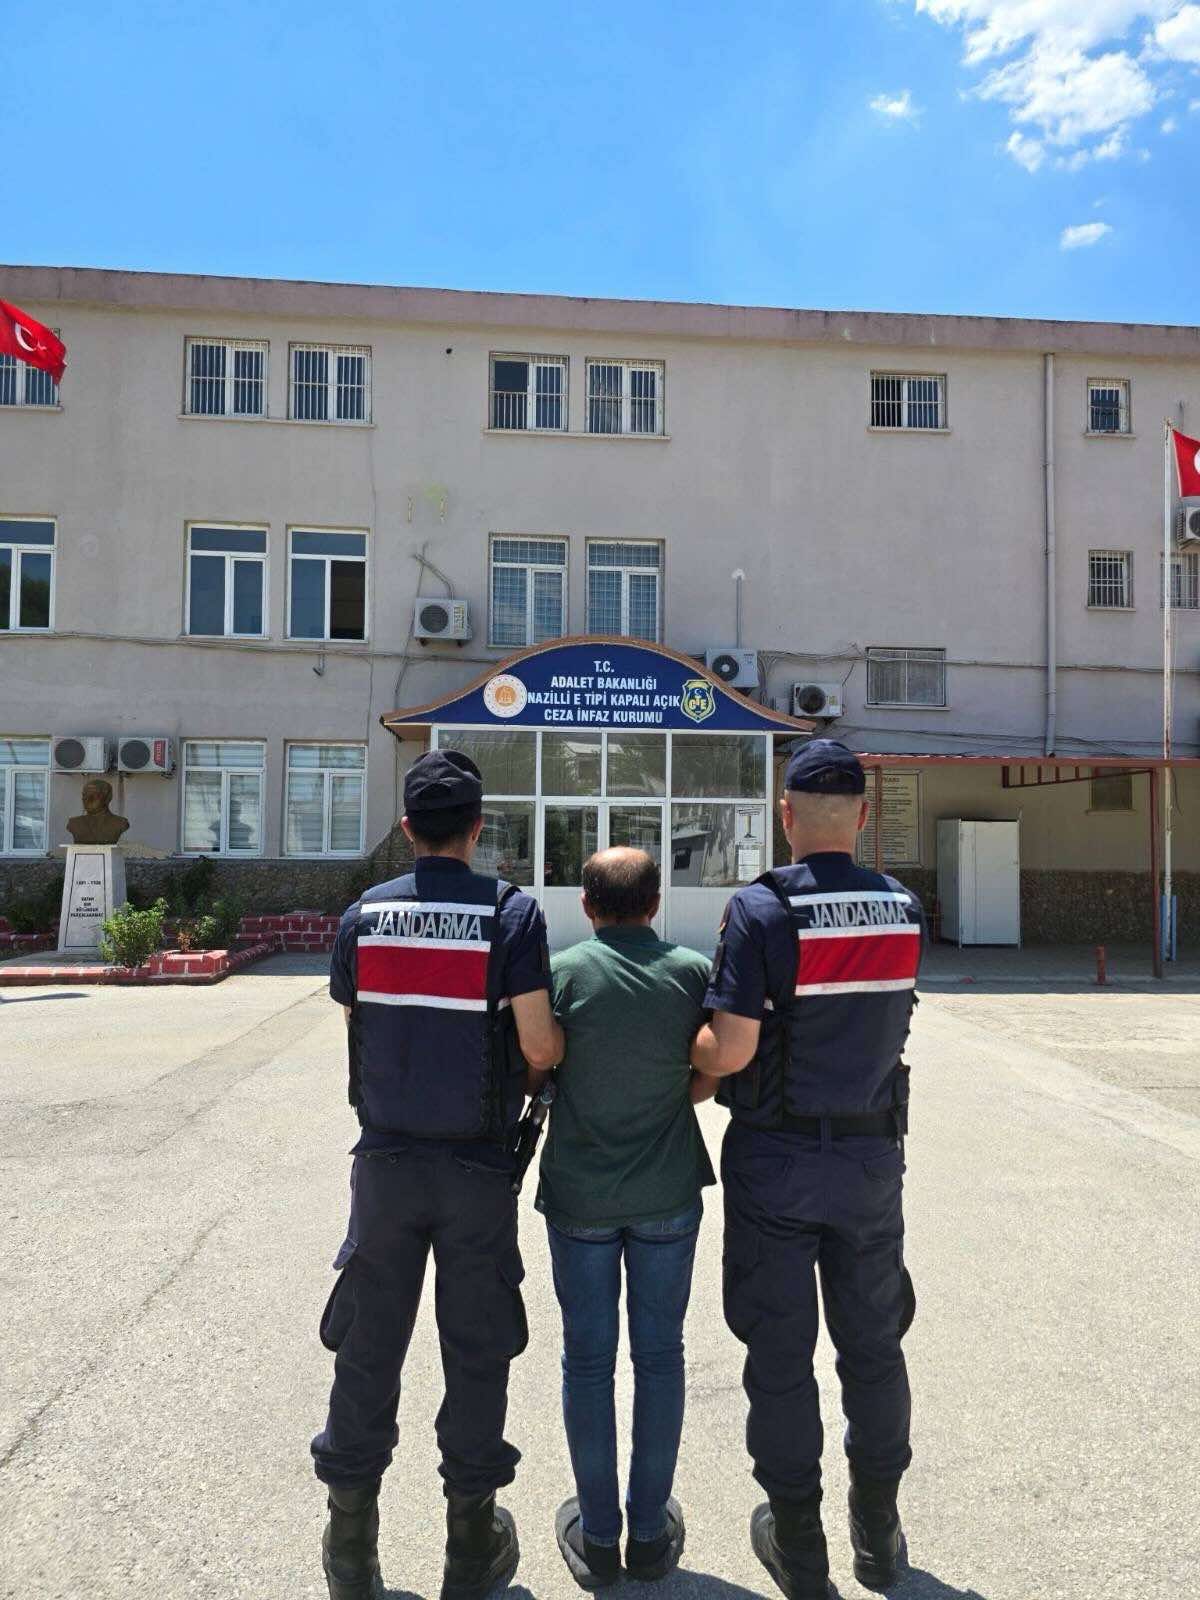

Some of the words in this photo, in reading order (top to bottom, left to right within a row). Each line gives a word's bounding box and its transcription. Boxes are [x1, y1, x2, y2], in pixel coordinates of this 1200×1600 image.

[594, 660, 615, 673] T.C.
[551, 676, 594, 688] ADALET
[597, 676, 657, 690] BAKANLIĞI
[528, 692, 571, 704] NAZİLLİ
[574, 694, 581, 704] E
[584, 693, 608, 706] TİPİ
[611, 694, 650, 706] KAPALI
[654, 695, 680, 709] AÇIK
[544, 708, 574, 722] CEZA
[577, 707, 609, 722] İNFAZ
[613, 709, 663, 724] KURUMU
[809, 901, 910, 929] JANDARMA
[370, 910, 483, 941] JANDARMA
